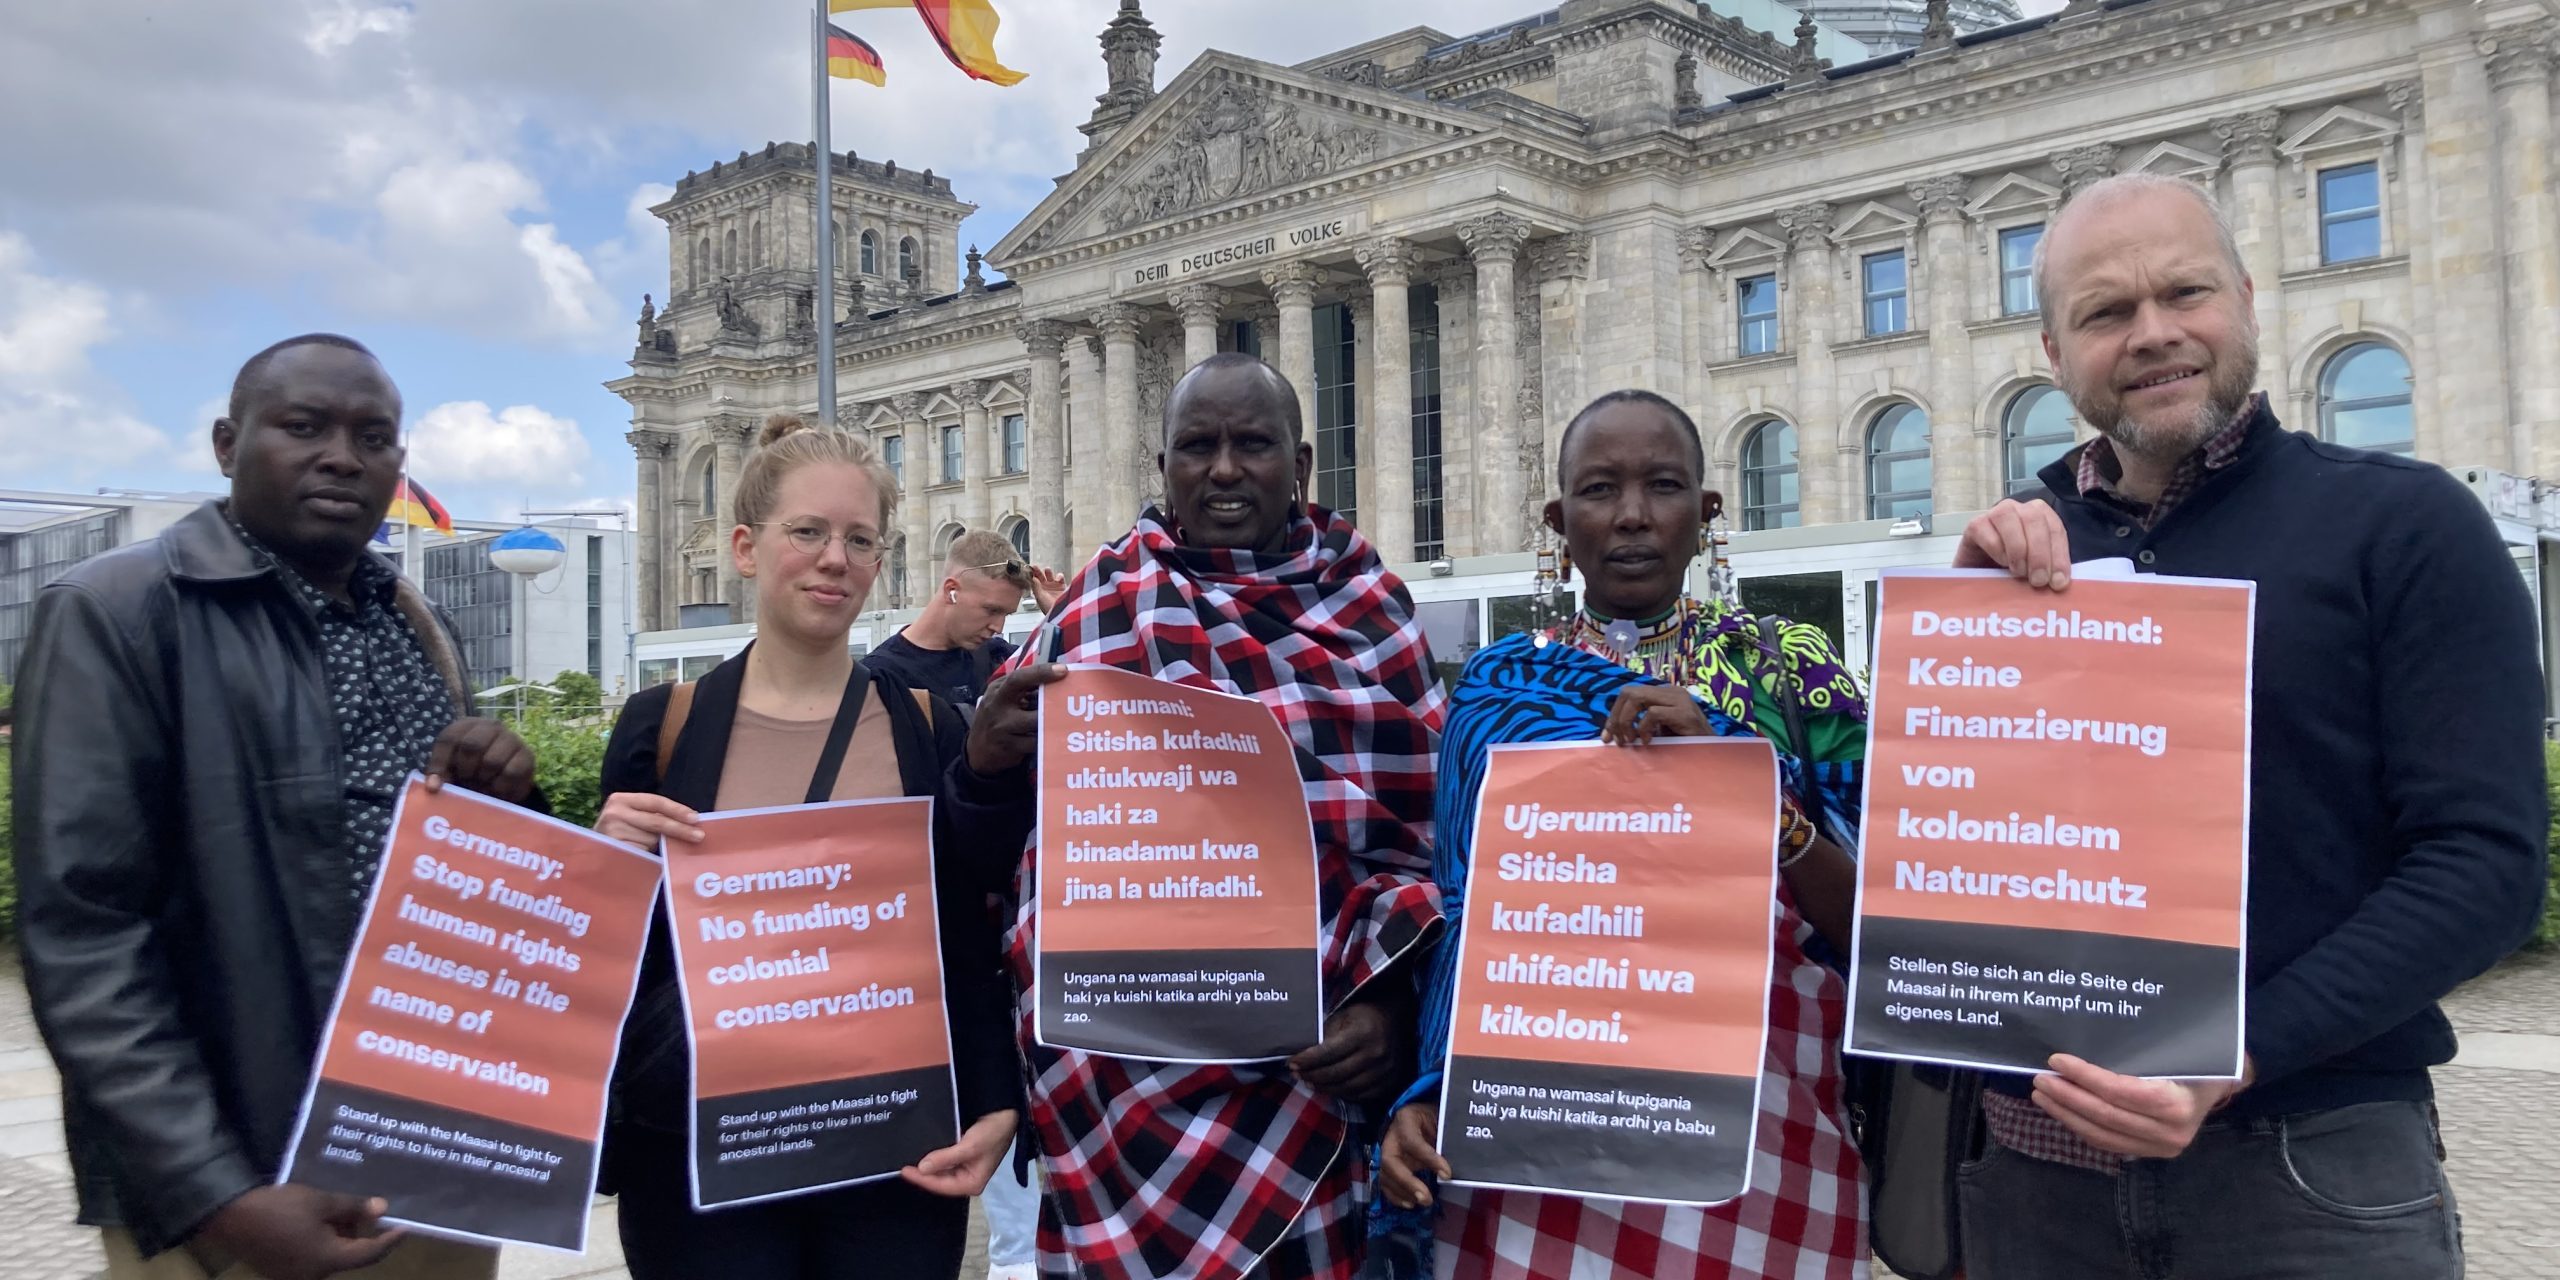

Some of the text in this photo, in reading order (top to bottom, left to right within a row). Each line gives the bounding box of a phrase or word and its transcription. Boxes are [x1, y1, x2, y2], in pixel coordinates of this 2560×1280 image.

[1135, 221, 1342, 284] DEM DEUTSCHEN VOLKE
[1911, 610, 2162, 644] Deutschland:
[1908, 656, 2022, 687] Keine
[1067, 694, 1195, 722] Ujerumani:
[1067, 729, 1261, 754] Sitisha kufadhili
[1905, 706, 2167, 756] Finanzierung
[1067, 764, 1237, 792] ukiukwaji wa
[1902, 765, 1975, 788] von
[1066, 803, 1158, 826] haki za
[1504, 802, 1692, 840] Ujerumani:
[1898, 808, 2120, 850] kolonialem
[423, 816, 565, 881] Germany:
[1066, 838, 1259, 863] binadamu kwa
[695, 863, 851, 898] Germany:
[1498, 851, 1617, 884] Sitisha
[1895, 860, 2147, 908] Naturschutz
[413, 854, 591, 937] Stop funding
[1062, 874, 1263, 907] jina la uhifadhi.
[399, 894, 581, 972] human rights
[699, 893, 907, 942] No funding of
[1492, 902, 1644, 938] kufadhili
[384, 941, 570, 1012] abuses in the
[707, 947, 830, 985] colonial
[1064, 969, 1265, 987] Ungana na wamasai kupigania
[1486, 953, 1695, 993] uhifadhi wa
[1889, 956, 2164, 994] Stellen Sie sich an die Seite der
[370, 986, 493, 1033] name of
[715, 983, 914, 1030] conservation
[1064, 989, 1289, 1006] haki ya kuishi katika ardhi ya babu
[1885, 1004, 2002, 1026] eigenes Land.
[1887, 979, 2142, 1016] Maasai in ihrem Kampf um ihr
[1063, 1012, 1092, 1023] zao.
[1480, 1004, 1629, 1044] kikoloni.
[358, 1031, 549, 1094] conservation
[720, 1088, 918, 1126] Stand up with the Maasai to fight
[1472, 1080, 1691, 1112] Ungana na wamasai kupigania
[337, 1105, 563, 1165] Stand up with the Maasai to fight for
[720, 1110, 892, 1144] for their rights to live in their
[1466, 1125, 1493, 1139] zao.
[1469, 1101, 1716, 1136] haki ya kuishi katika ardhi ya babu
[326, 1144, 365, 1162] lands.
[332, 1125, 551, 1181] their rights to live in their ancestral
[719, 1138, 816, 1161] ancestral lands.
